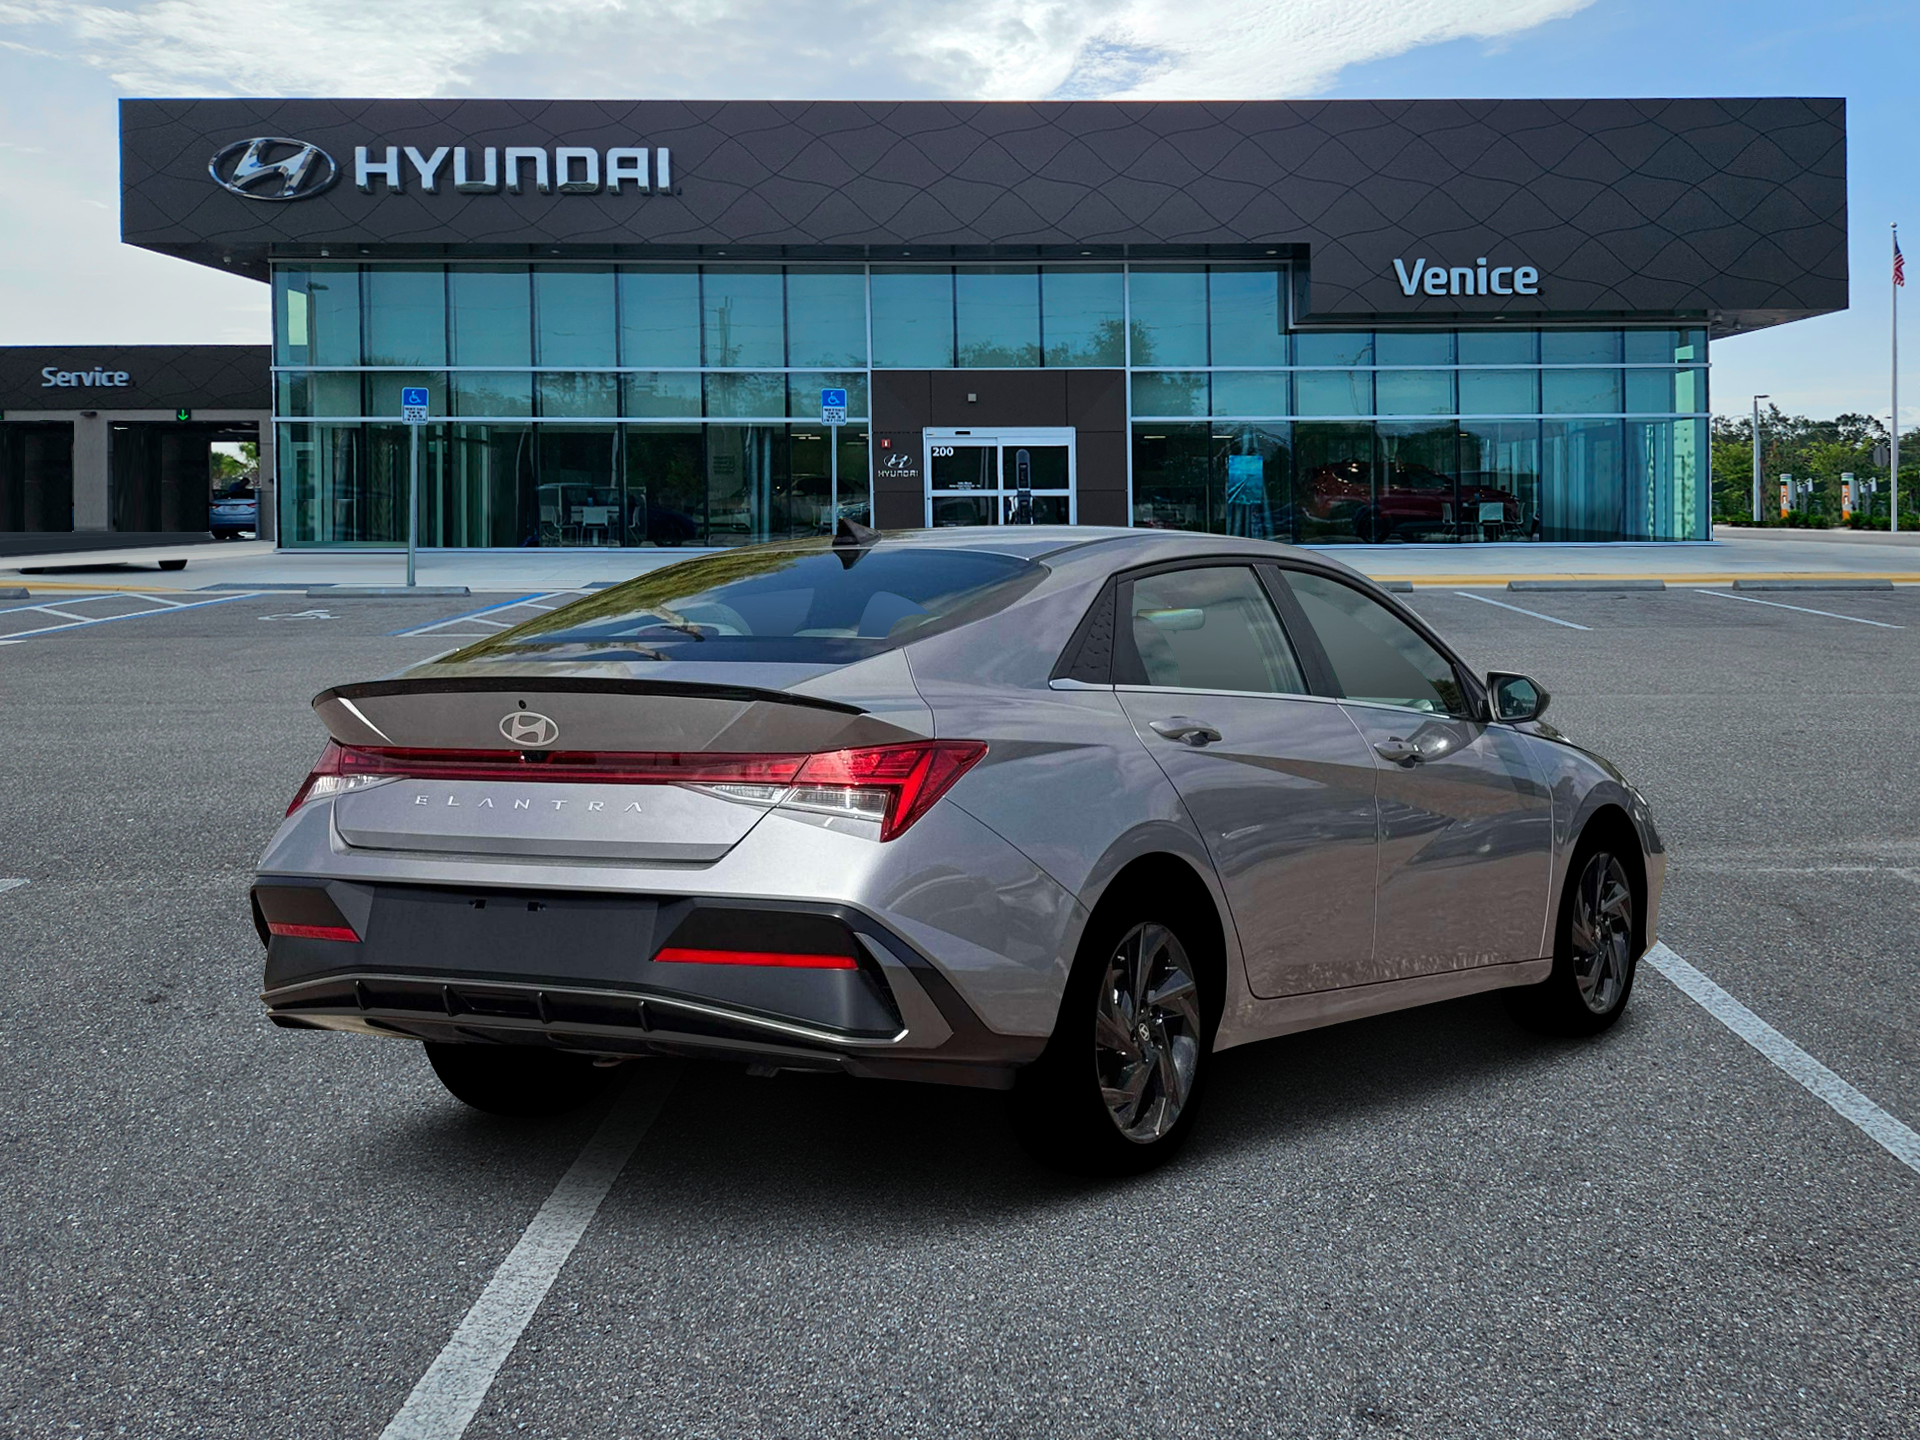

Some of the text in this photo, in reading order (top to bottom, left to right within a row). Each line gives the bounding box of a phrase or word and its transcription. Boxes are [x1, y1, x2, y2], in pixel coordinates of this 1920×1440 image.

[354, 146, 671, 194] HYUNDAI
[1393, 257, 1538, 295] Venice
[41, 367, 130, 387] Service
[933, 447, 954, 457] 200
[878, 470, 919, 478] HYUNDAI
[414, 795, 643, 813] ELANTRA
